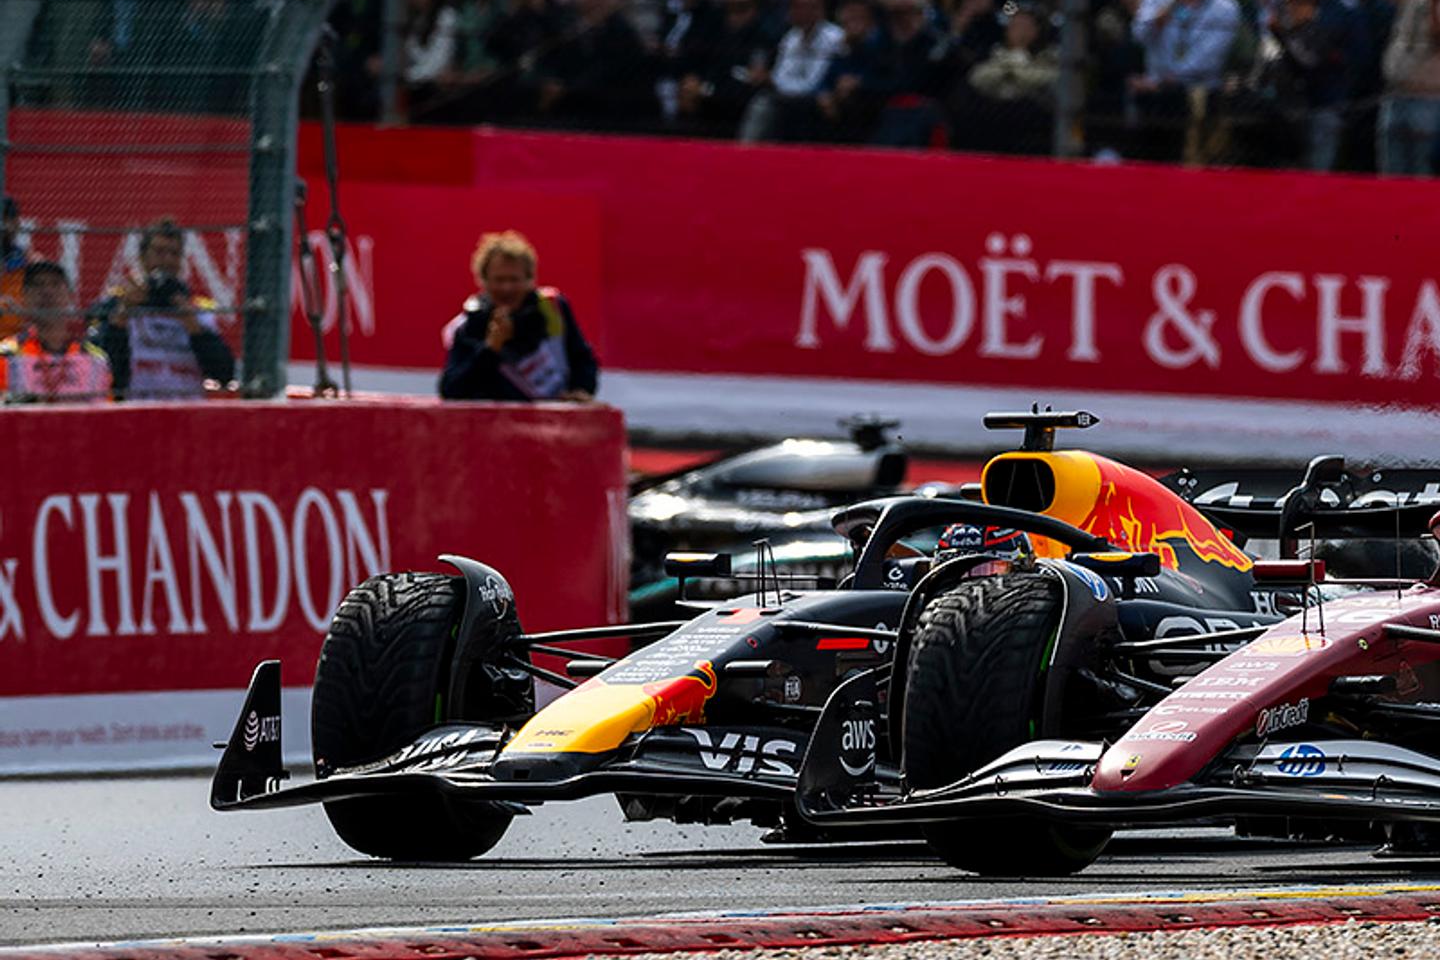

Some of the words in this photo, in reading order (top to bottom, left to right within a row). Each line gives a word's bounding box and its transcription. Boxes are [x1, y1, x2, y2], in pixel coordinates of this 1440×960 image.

[796, 232, 1123, 362] MOËT
[1142, 263, 1220, 369] &
[681, 728, 798, 777] VIS
[841, 719, 877, 750] aws
